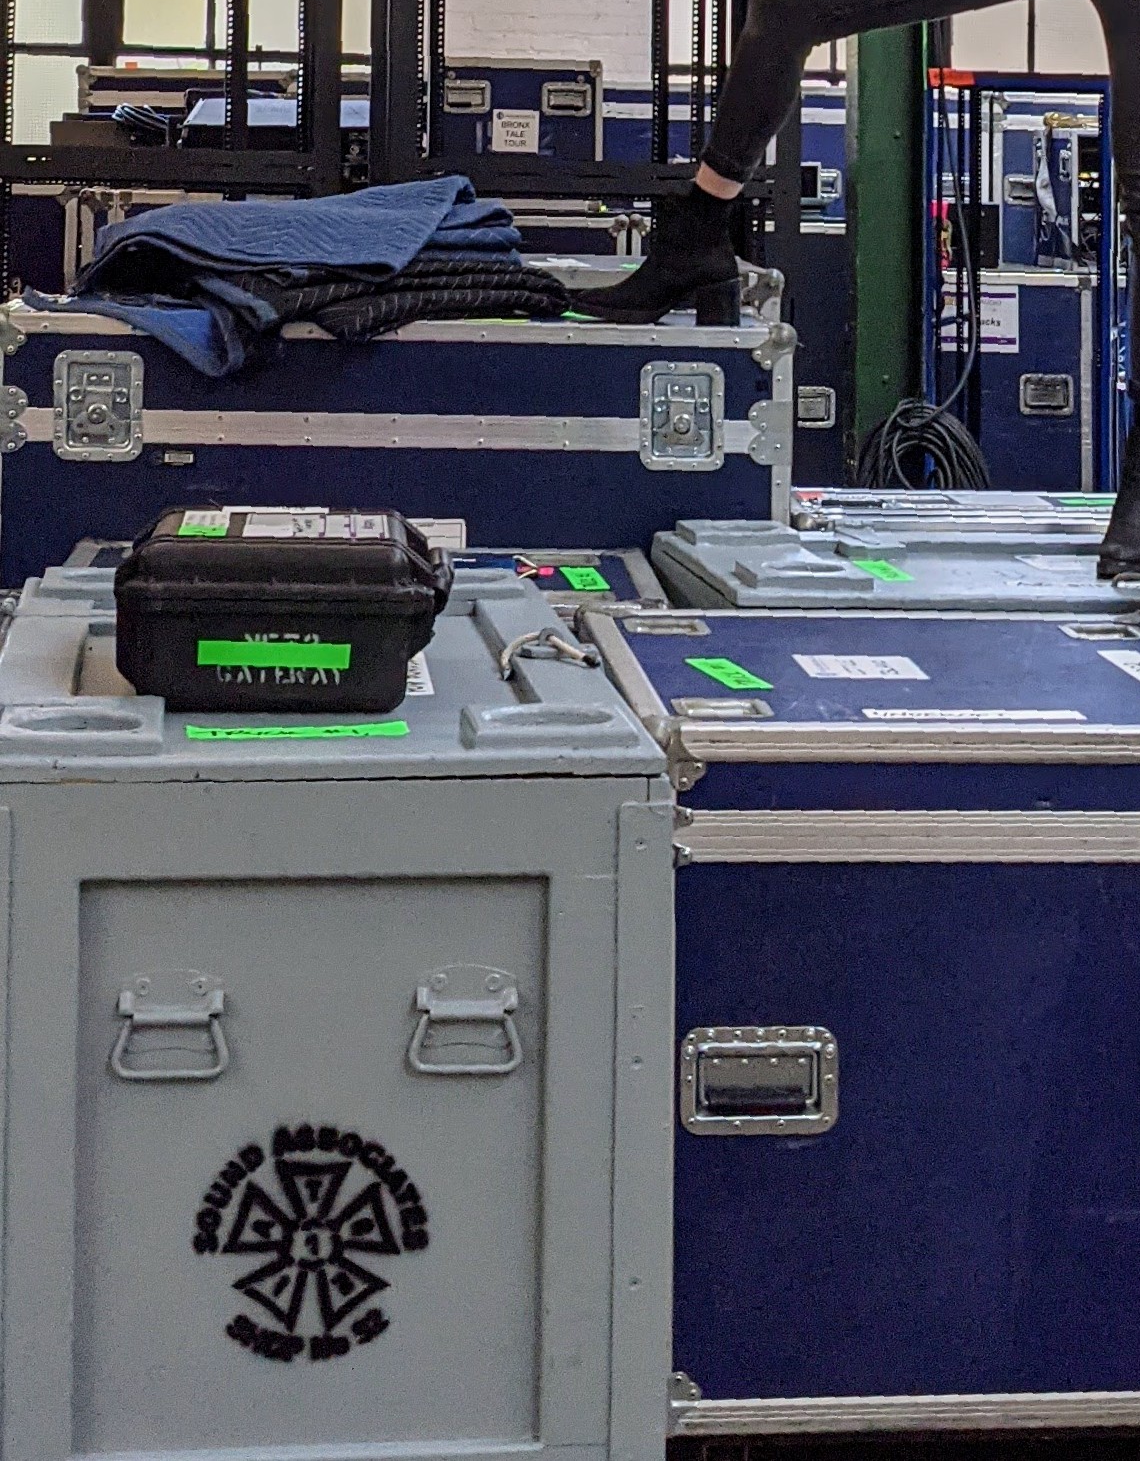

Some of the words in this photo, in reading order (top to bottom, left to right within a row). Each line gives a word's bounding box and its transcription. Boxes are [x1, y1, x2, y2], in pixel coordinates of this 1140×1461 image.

[501, 120, 531, 129] BRONX
[506, 130, 526, 138] TALE
[504, 139, 527, 147] TOUR
[192, 1143, 265, 1255] SOUND
[272, 1123, 430, 1252] ASSOCIATES
